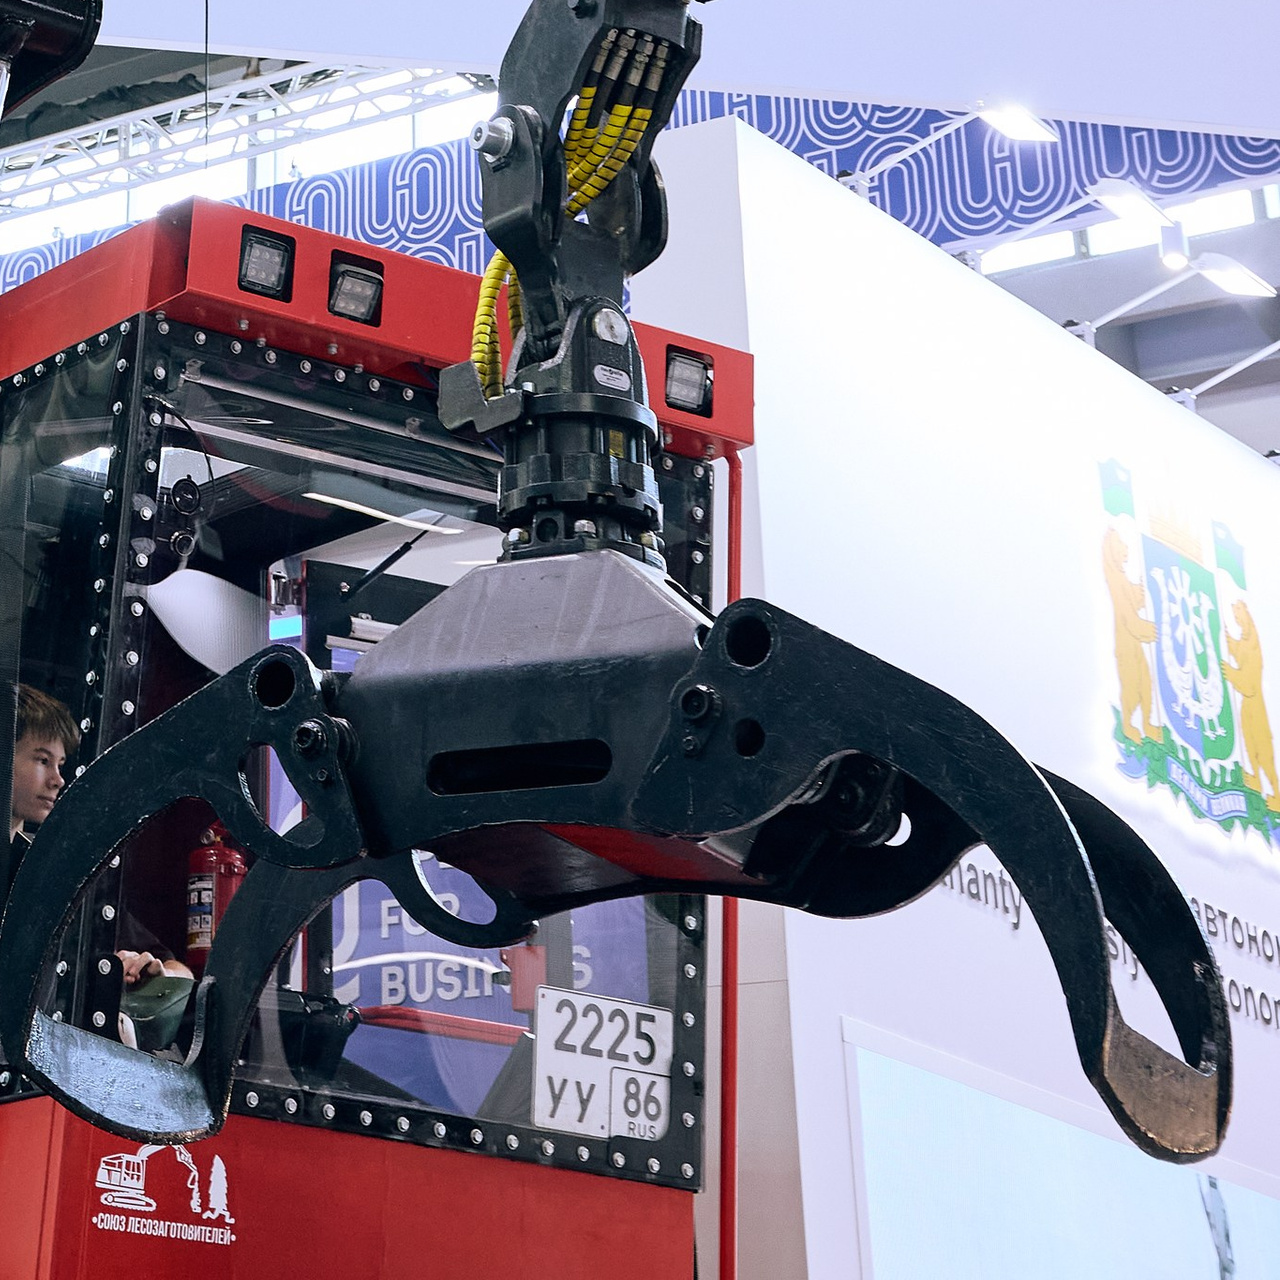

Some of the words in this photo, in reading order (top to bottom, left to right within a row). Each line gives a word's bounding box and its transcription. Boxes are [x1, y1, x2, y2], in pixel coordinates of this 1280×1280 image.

[554, 998, 657, 1066] 2225
[623, 1077, 662, 1122] 86
[627, 1121, 657, 1140] RUS
[97, 1212, 126, 1232] СОЮЗ
[126, 1216, 231, 1246] ЛЕСОЗАГОТОВИТЕЛЕЙ
